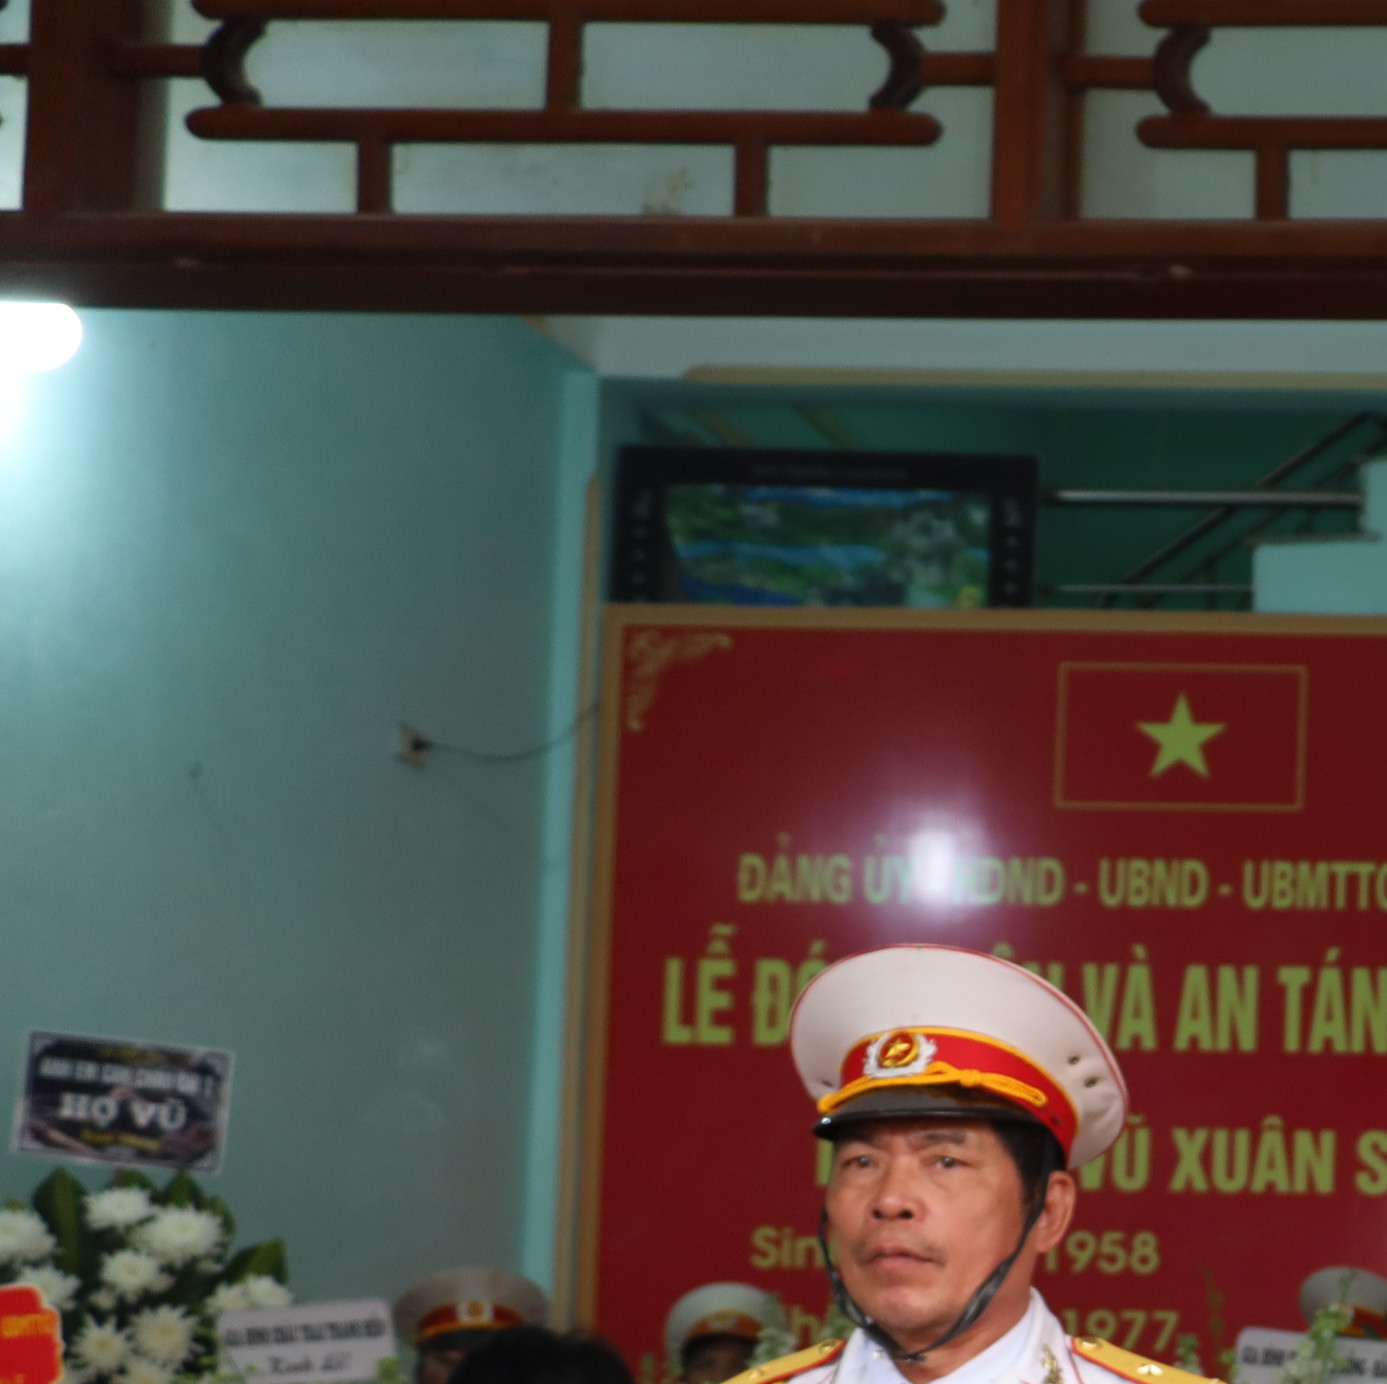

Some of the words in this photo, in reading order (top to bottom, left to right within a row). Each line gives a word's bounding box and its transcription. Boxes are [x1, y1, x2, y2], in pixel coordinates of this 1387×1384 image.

[737, 831, 852, 905] ĐẢNG
[1098, 858, 1209, 909] UBND
[661, 922, 738, 1046] LỄ
[1081, 943, 1158, 1053] VÀ
[1172, 962, 1261, 1055] AN
[1168, 1114, 1336, 1194] XUÂN
